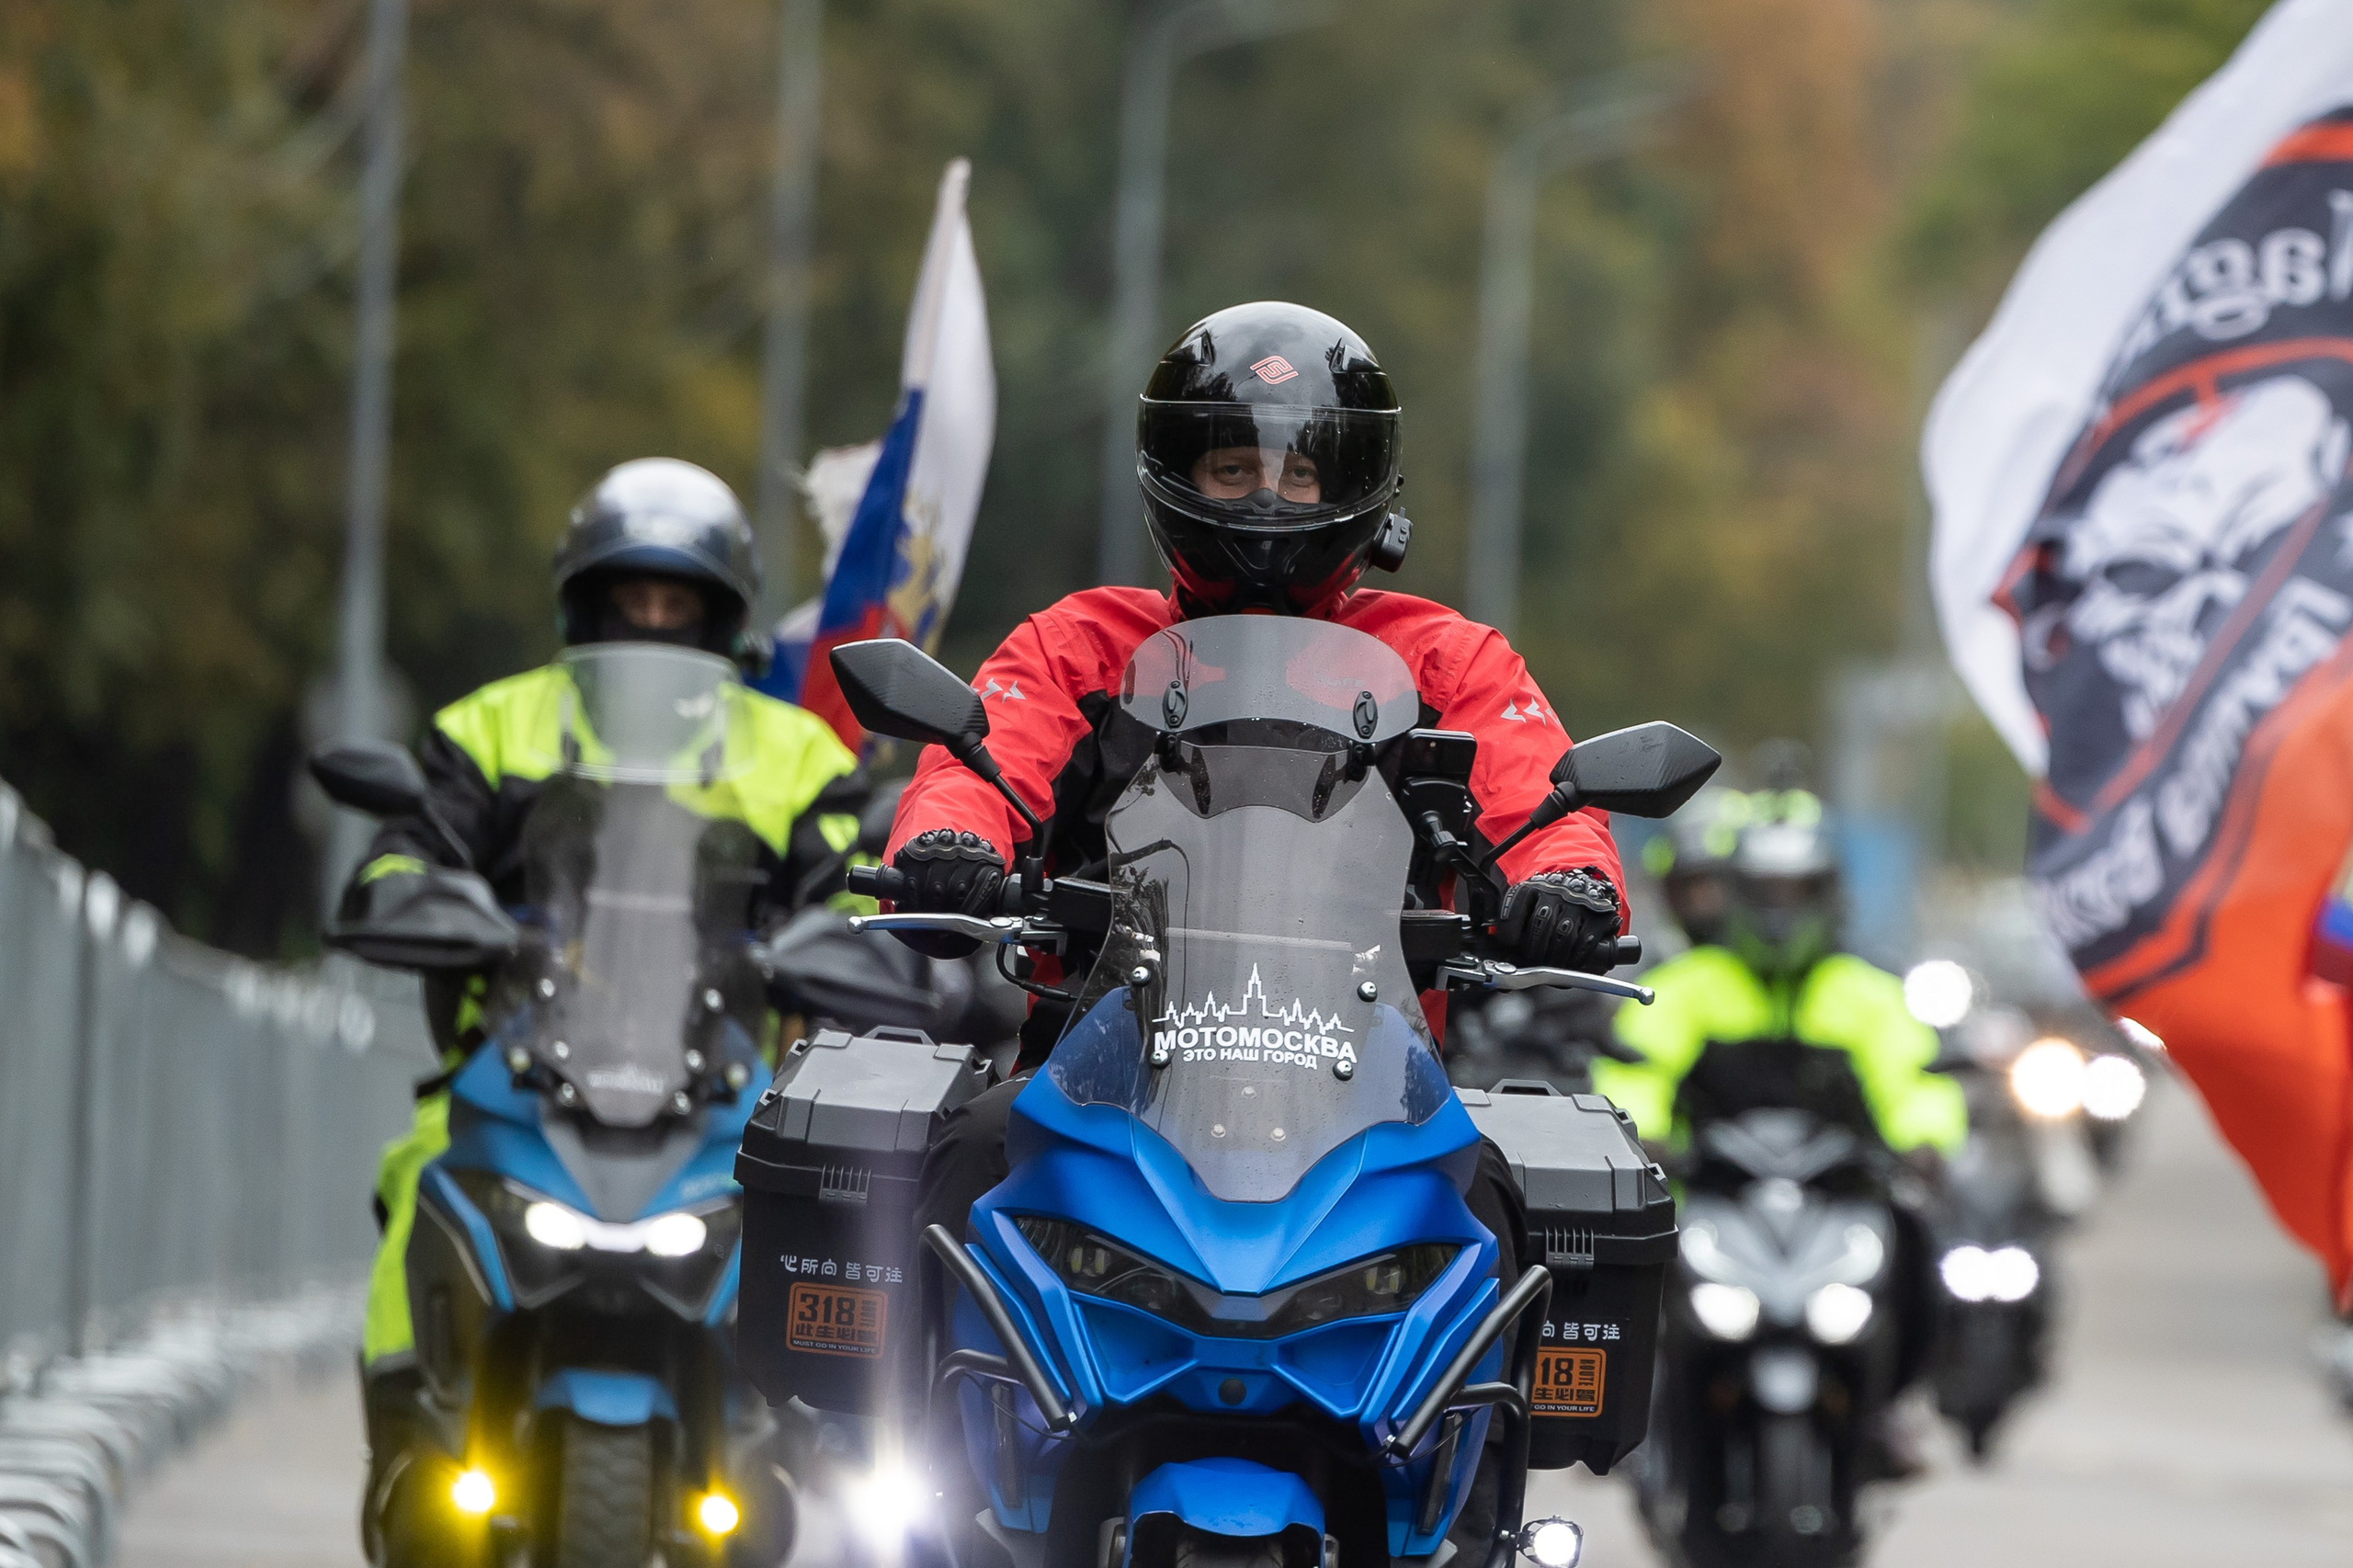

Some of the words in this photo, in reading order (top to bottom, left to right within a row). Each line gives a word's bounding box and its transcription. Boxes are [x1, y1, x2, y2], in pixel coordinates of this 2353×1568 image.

[1154, 1027, 1358, 1063] МОТОМОСКВА
[1183, 1048, 1217, 1062] ЭТО
[1220, 1048, 1259, 1062] НАШ
[1263, 1050, 1318, 1070] ГОРОД
[798, 1293, 856, 1326] 318
[792, 1339, 813, 1347] MUST
[1541, 1357, 1574, 1386] 18
[1534, 1387, 1596, 1402] 生必驾
